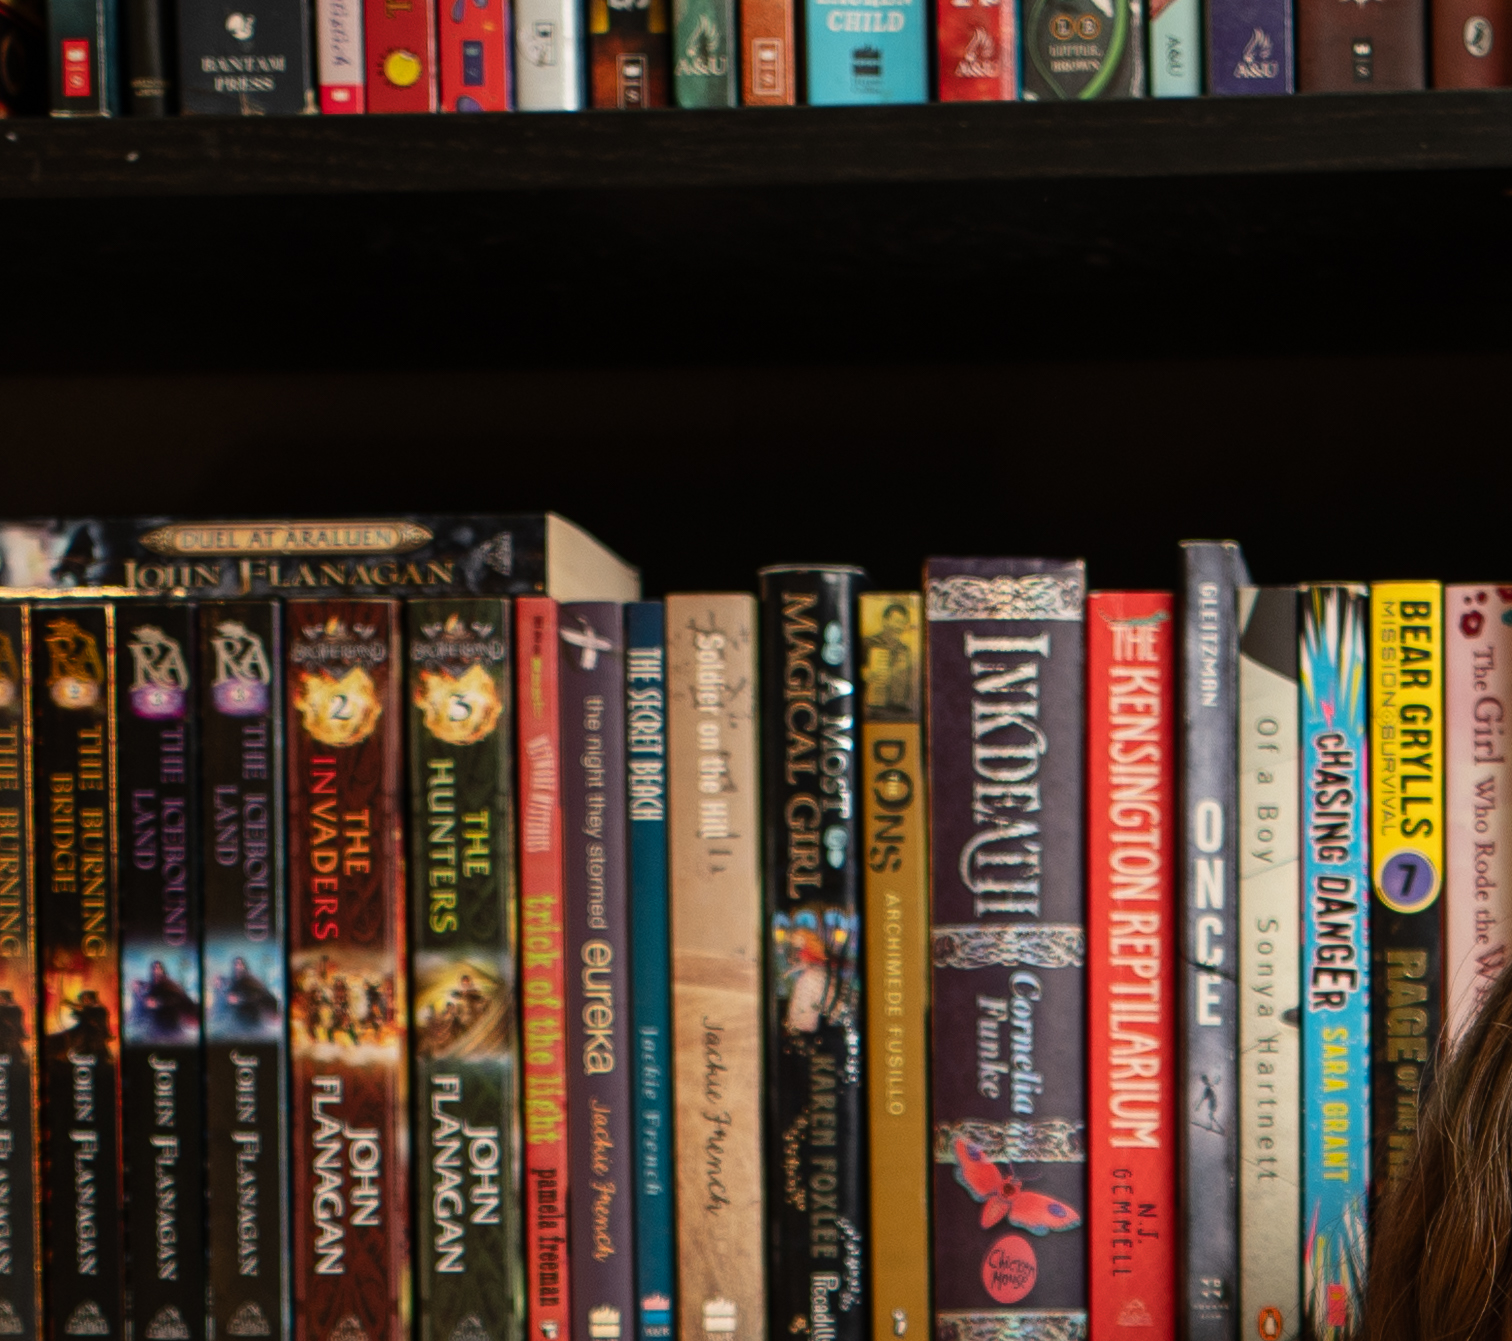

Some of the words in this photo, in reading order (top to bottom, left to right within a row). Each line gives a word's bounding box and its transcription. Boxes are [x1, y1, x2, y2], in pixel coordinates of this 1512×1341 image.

[1109, 623, 1157, 660] THE
[1399, 600, 1431, 690] BEAR
[960, 634, 1050, 916] INKDEATH
[1109, 667, 1160, 895] KENSINGTON
[1315, 732, 1350, 862] CHASING
[1401, 701, 1432, 839] GRYLLS
[311, 756, 340, 940] INVADERS
[344, 809, 370, 875] THE
[428, 760, 456, 934] HUNTERS
[463, 811, 488, 877] THE
[1195, 802, 1221, 1026] ONCE
[1311, 876, 1355, 1011] DANGER
[581, 941, 614, 1075] eureka
[1109, 911, 1160, 1149] REPTILARIUM
[1111, 1168, 1132, 1276] GEMMELL
[1138, 1205, 1159, 1242] N.J.
